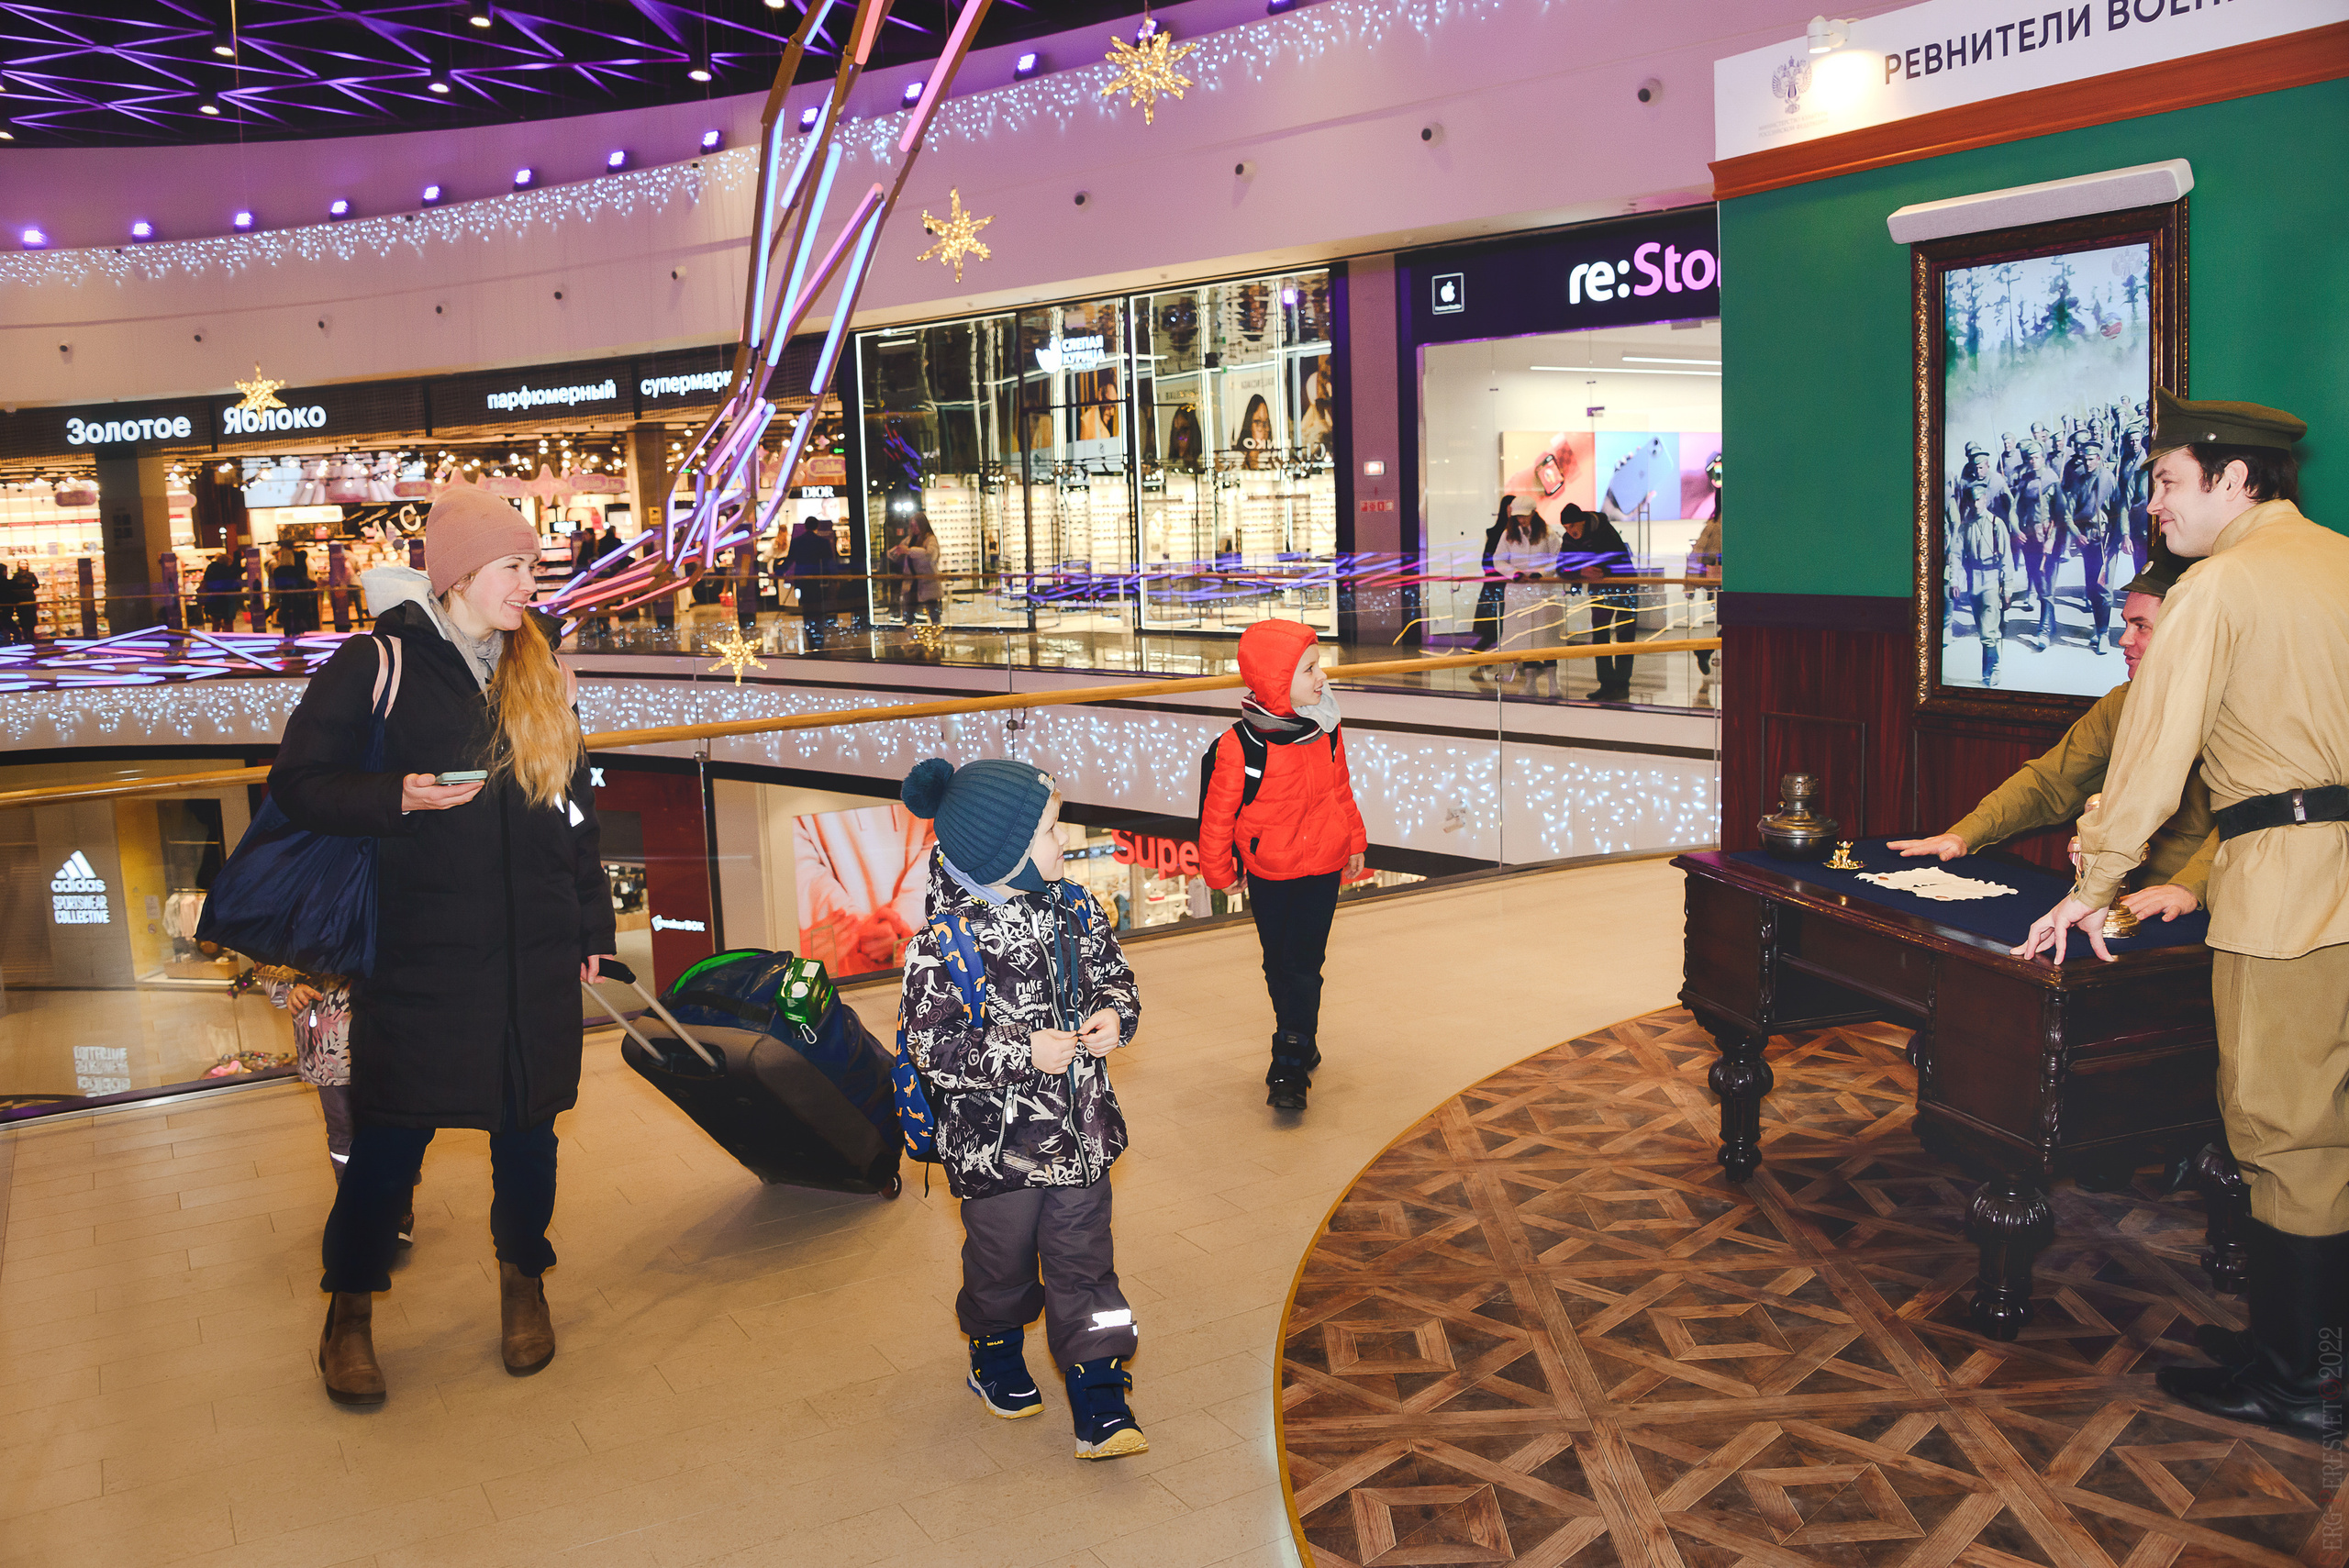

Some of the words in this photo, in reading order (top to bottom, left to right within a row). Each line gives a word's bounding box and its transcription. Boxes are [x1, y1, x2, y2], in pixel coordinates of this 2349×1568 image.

[1885, 4, 2090, 84] РЕВНИТЕЛИ
[1569, 241, 1722, 305] re:Sto
[1062, 335, 1105, 352] СЛЕПАЯ
[66, 417, 192, 445] Золотое
[223, 406, 327, 434] Яблоко
[487, 378, 617, 411] парфюмерный
[640, 368, 752, 398] супермарк
[802, 485, 835, 498] DIOR
[1111, 829, 1201, 881] Supe
[50, 879, 106, 893] adidas
[52, 895, 109, 910] SPORTSWEAR
[54, 909, 111, 924] COLLECTIVE
[1016, 980, 1043, 996] MAKE
